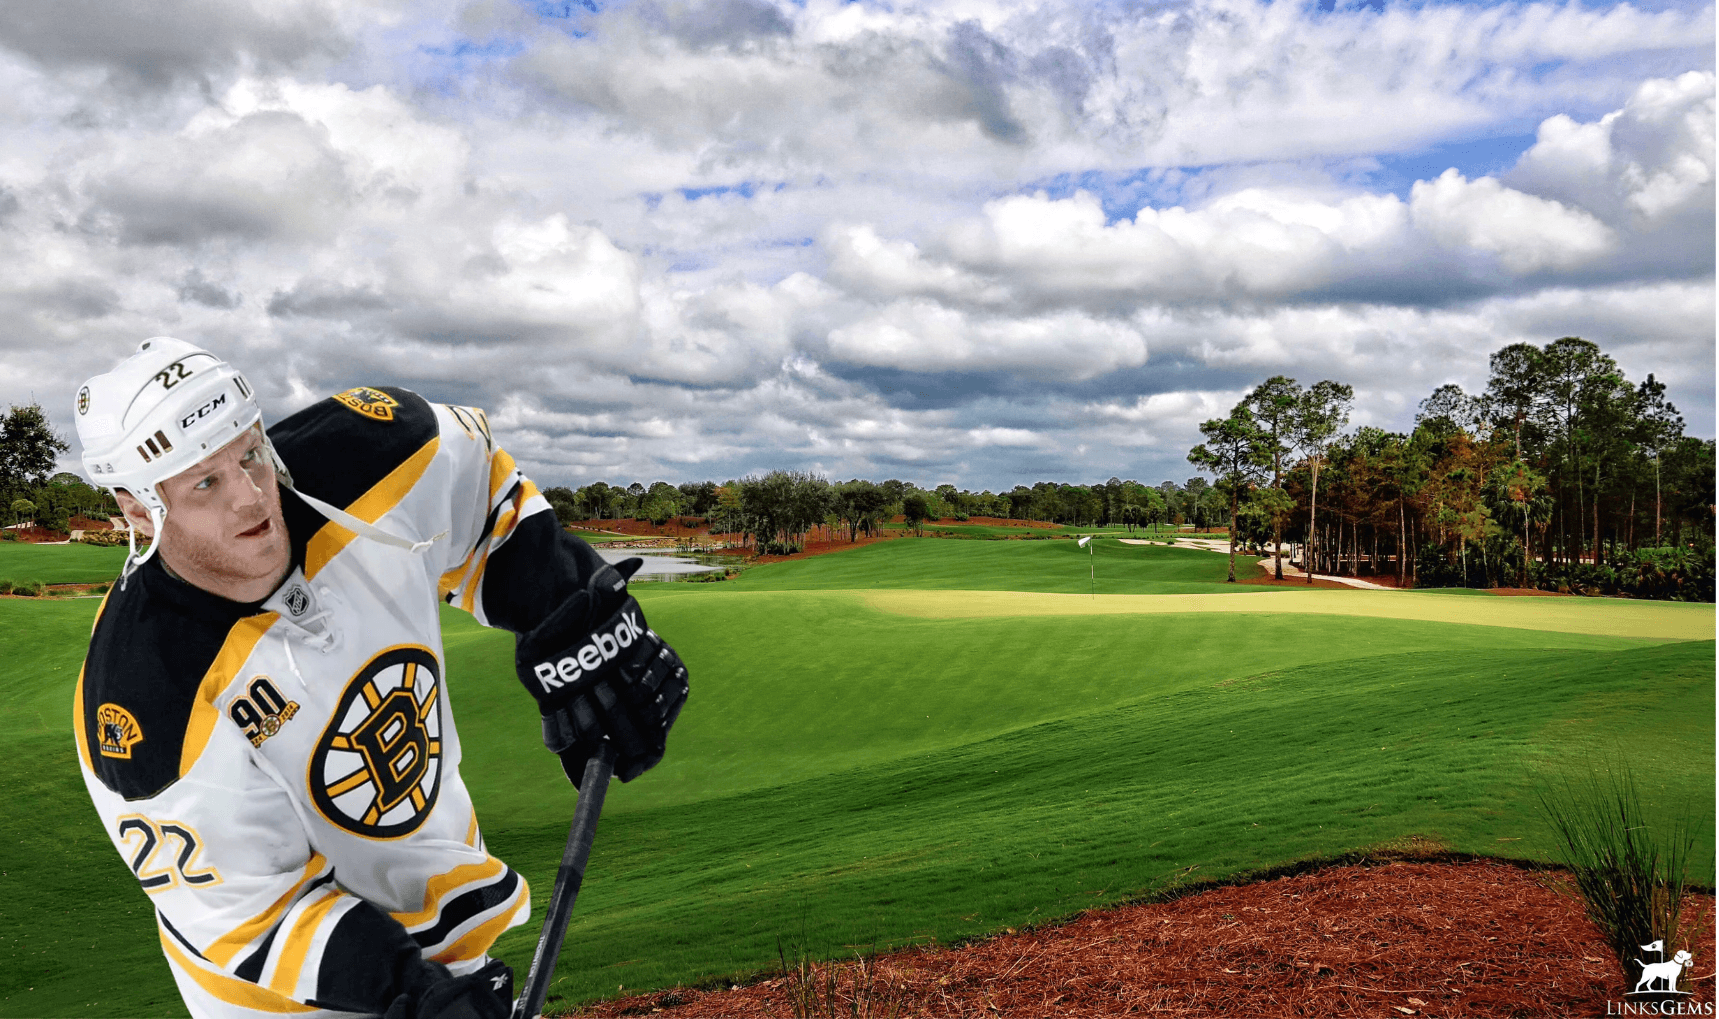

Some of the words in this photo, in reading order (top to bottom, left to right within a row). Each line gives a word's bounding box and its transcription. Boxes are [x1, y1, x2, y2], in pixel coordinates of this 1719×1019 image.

[155, 362, 193, 390] 22
[182, 393, 226, 429] CCM
[534, 611, 644, 694] Reebok
[98, 708, 138, 741] OSTON
[229, 675, 289, 741] 90
[281, 704, 294, 720] 2014
[350, 687, 430, 816] B
[117, 812, 224, 894] 22
